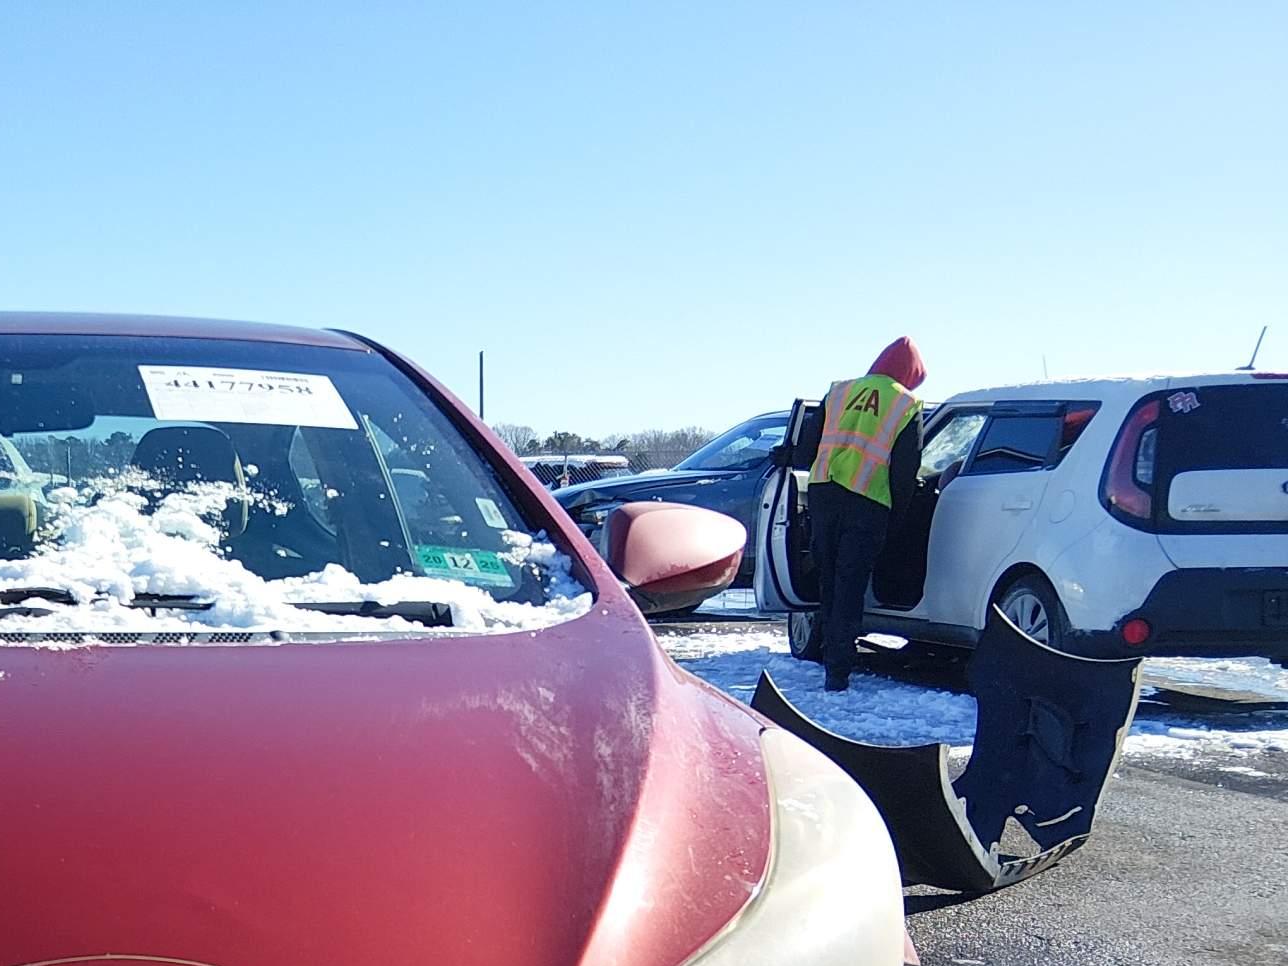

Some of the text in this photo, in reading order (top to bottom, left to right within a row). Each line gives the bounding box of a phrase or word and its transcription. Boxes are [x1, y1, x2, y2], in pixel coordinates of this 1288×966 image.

[165, 379, 314, 395] 44177958
[423, 554, 443, 565] 20
[448, 556, 474, 570] 12
